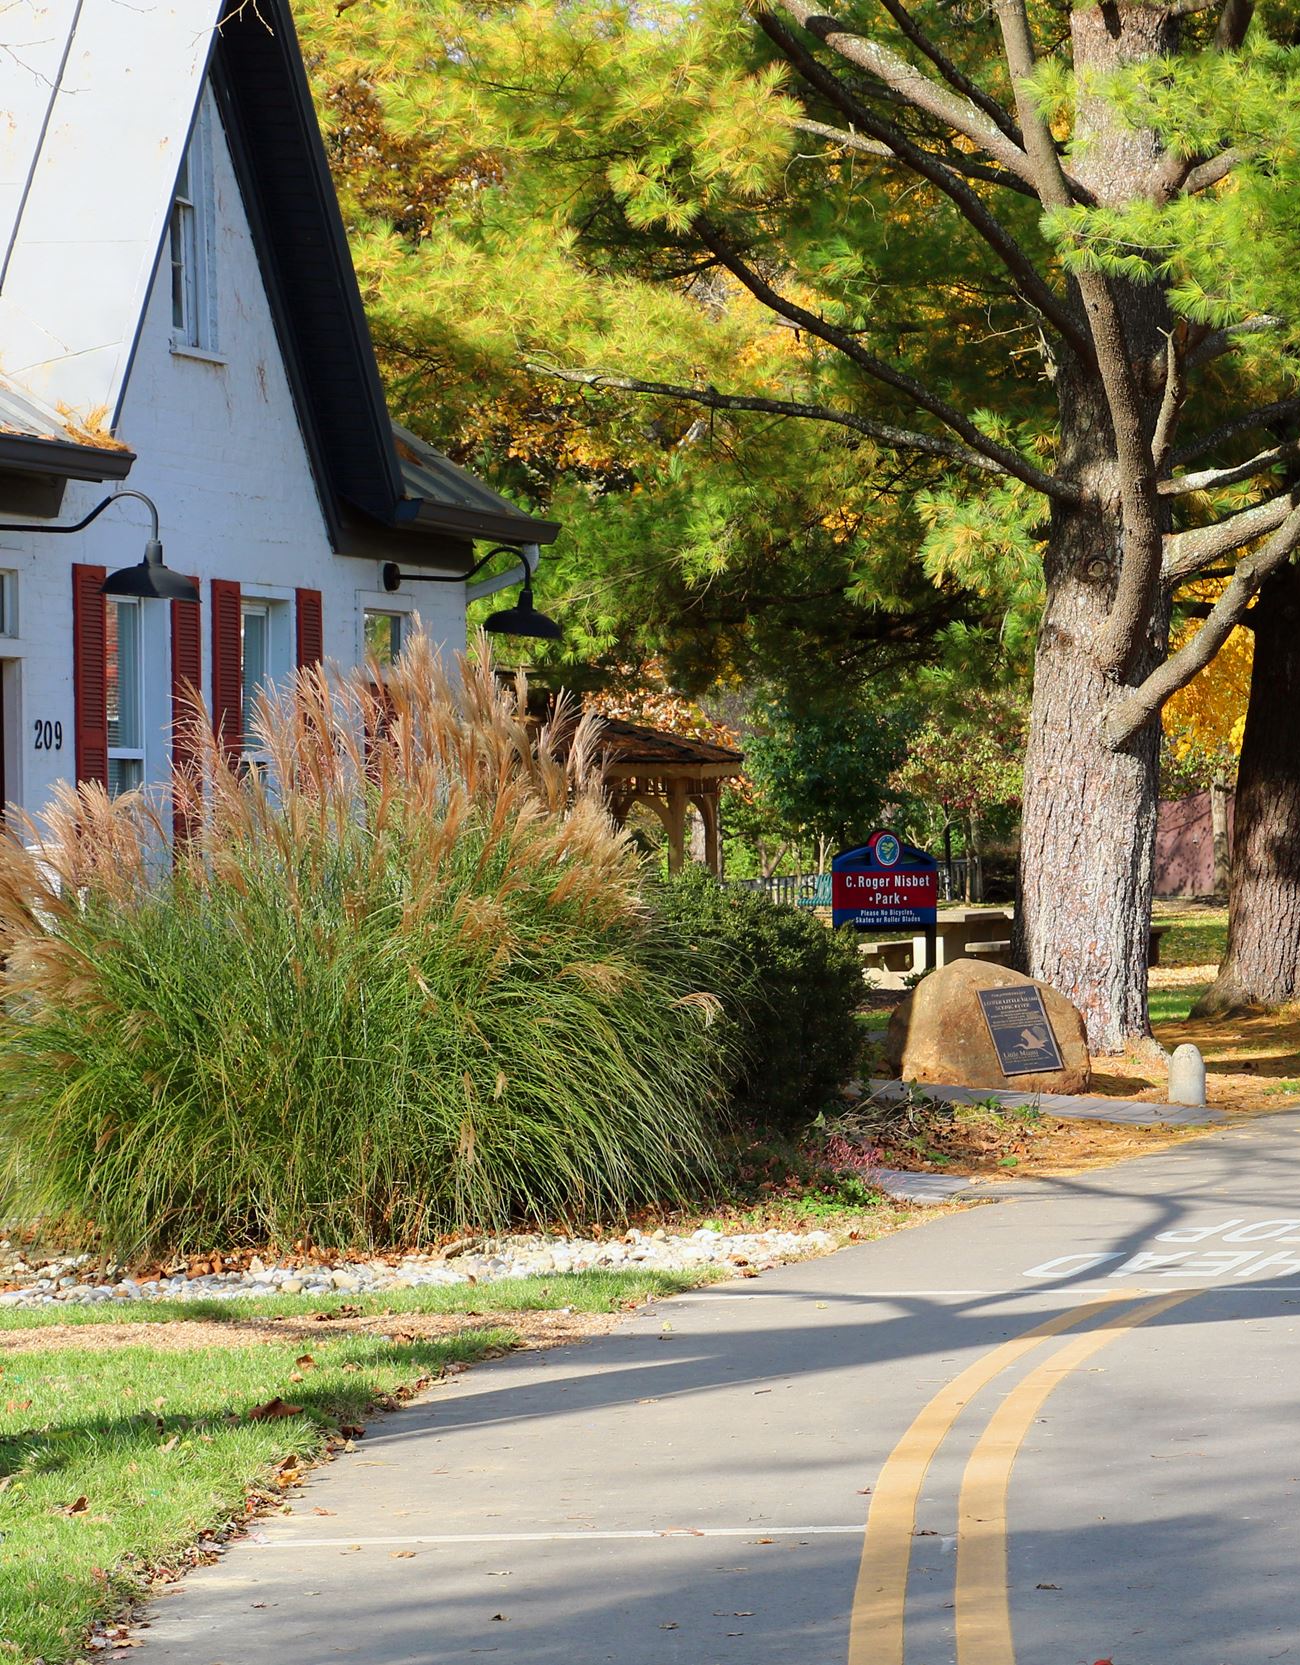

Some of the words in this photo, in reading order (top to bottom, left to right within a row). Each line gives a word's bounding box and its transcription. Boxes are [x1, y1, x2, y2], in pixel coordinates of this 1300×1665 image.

[34, 719, 62, 750] 209
[894, 875, 930, 887] Nisbet
[875, 892, 900, 904] Park
[855, 916, 875, 924] Skates
